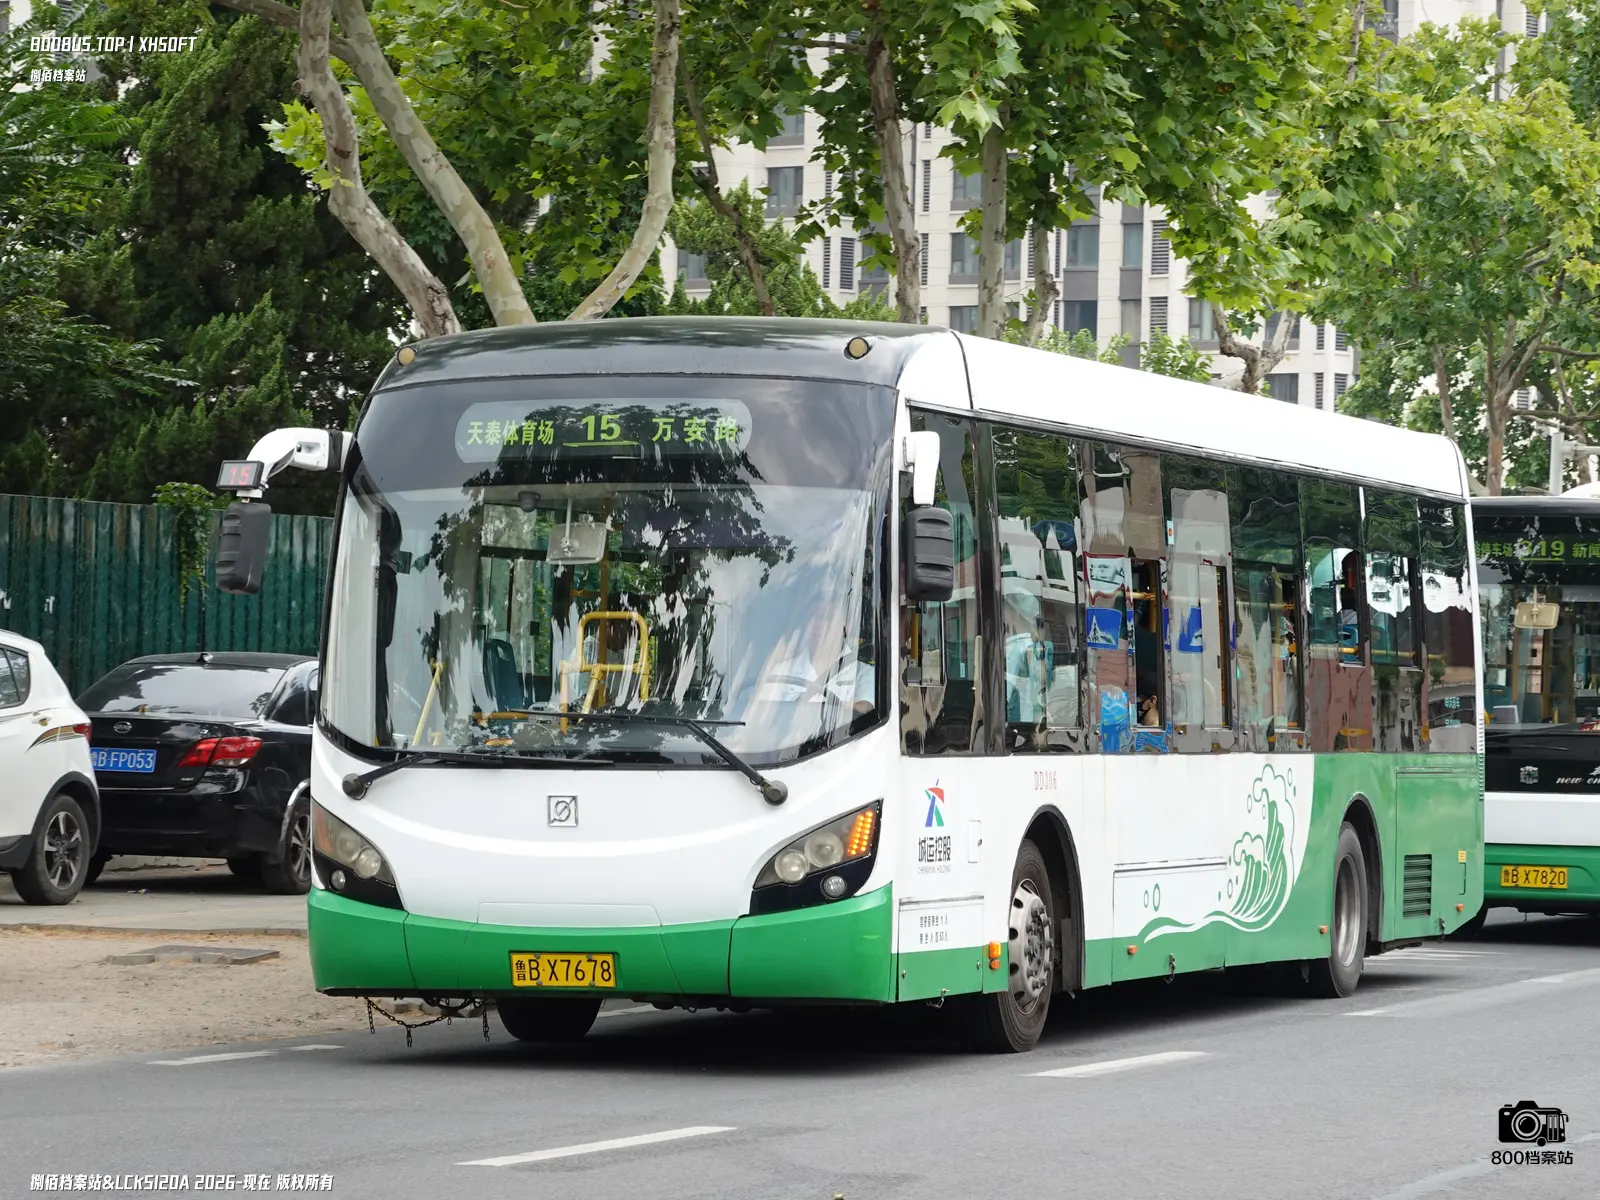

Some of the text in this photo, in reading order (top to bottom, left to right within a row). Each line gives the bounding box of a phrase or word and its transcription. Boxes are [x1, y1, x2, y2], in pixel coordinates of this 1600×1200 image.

[467, 413, 739, 446] 天泰体育场 15 万安路
[229, 465, 252, 486] 15
[918, 835, 951, 863] 城运控股
